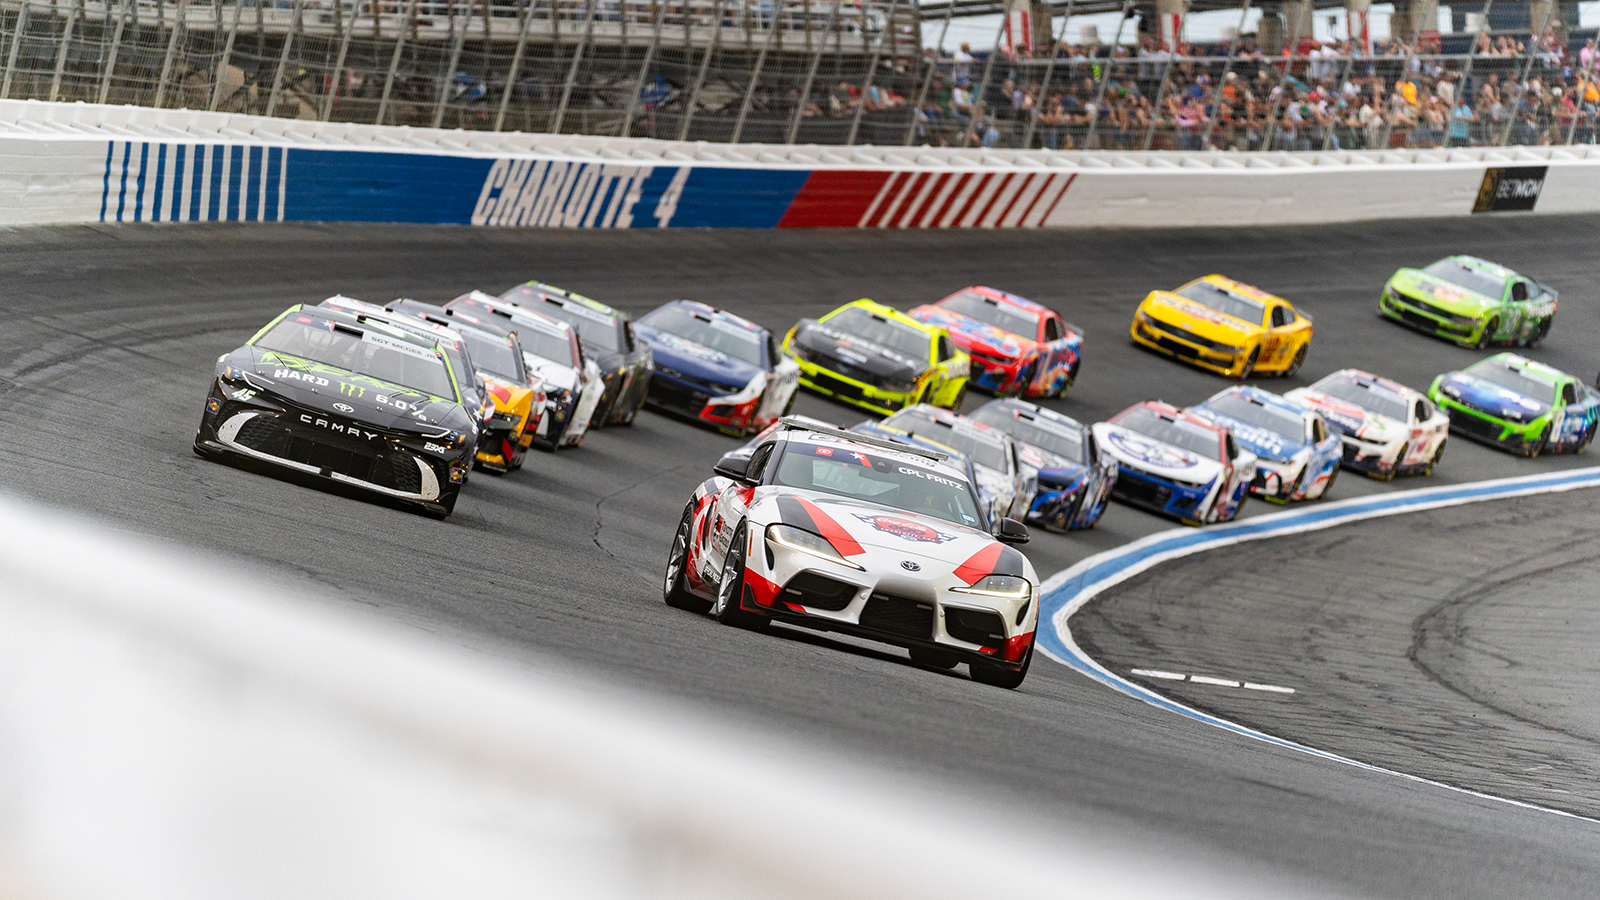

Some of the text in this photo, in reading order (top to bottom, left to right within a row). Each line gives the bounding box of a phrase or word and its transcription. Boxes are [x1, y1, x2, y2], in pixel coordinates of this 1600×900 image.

[471, 158, 692, 228] CHARLOTTE 4
[371, 336, 389, 345] SGT
[392, 342, 423, 356] MCGEE
[273, 369, 329, 387] HARD
[231, 388, 257, 401] 45
[375, 394, 427, 421] 6.0%
[300, 414, 379, 441] CAMRY
[898, 466, 964, 491] CPL FRITZ
